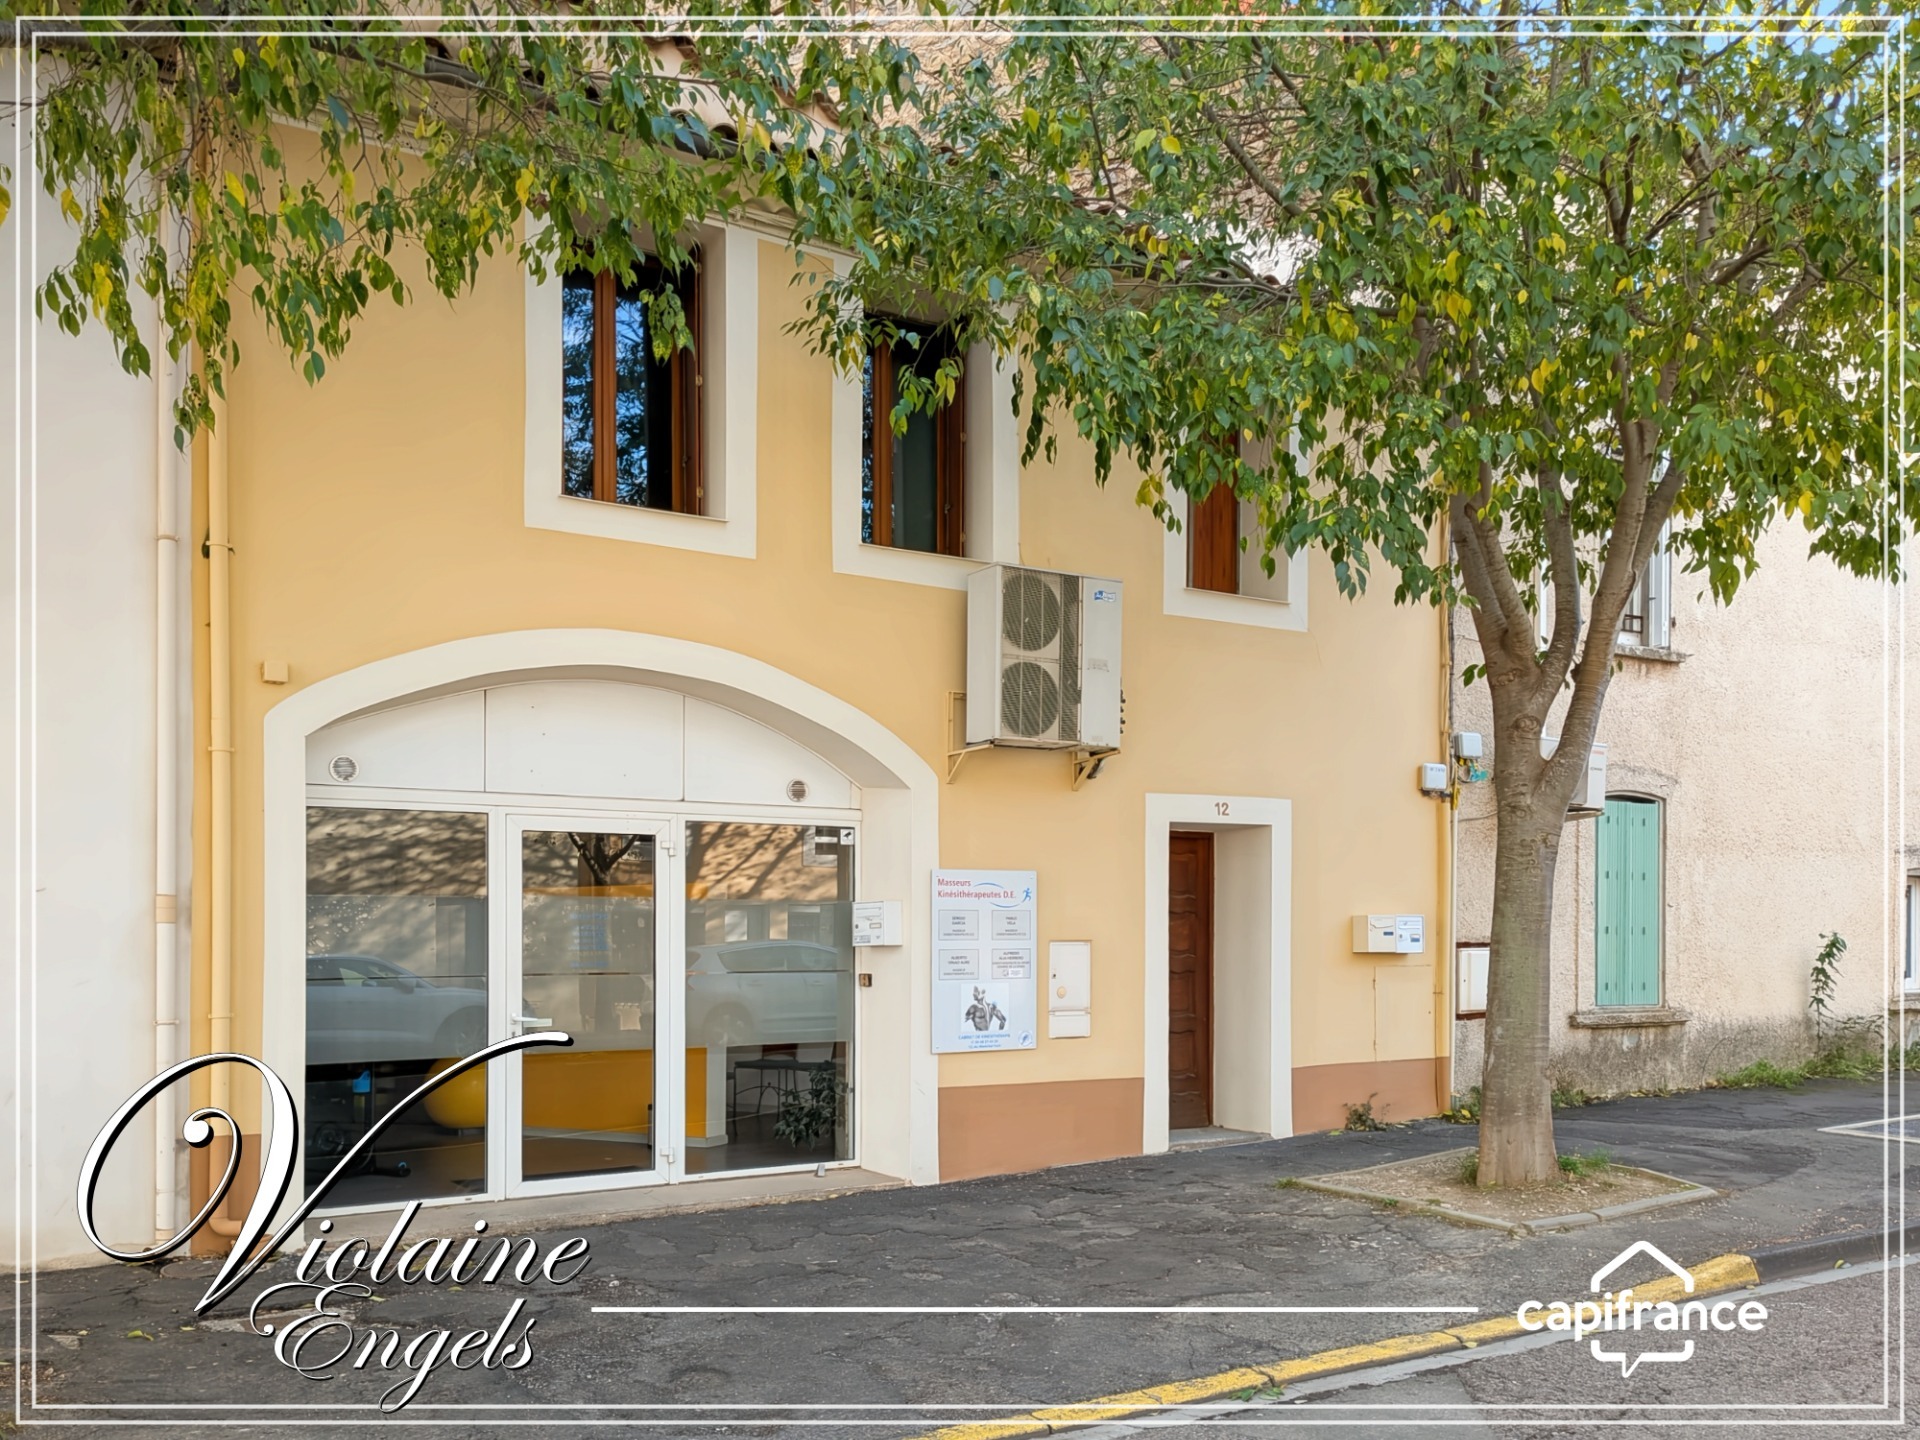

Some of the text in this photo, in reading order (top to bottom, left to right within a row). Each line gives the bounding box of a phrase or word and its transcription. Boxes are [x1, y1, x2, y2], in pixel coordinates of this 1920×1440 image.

[1214, 801, 1230, 816] 12
[937, 878, 971, 887] Masseurs
[937, 890, 1016, 900] Kinésithérapeutes D.E.
